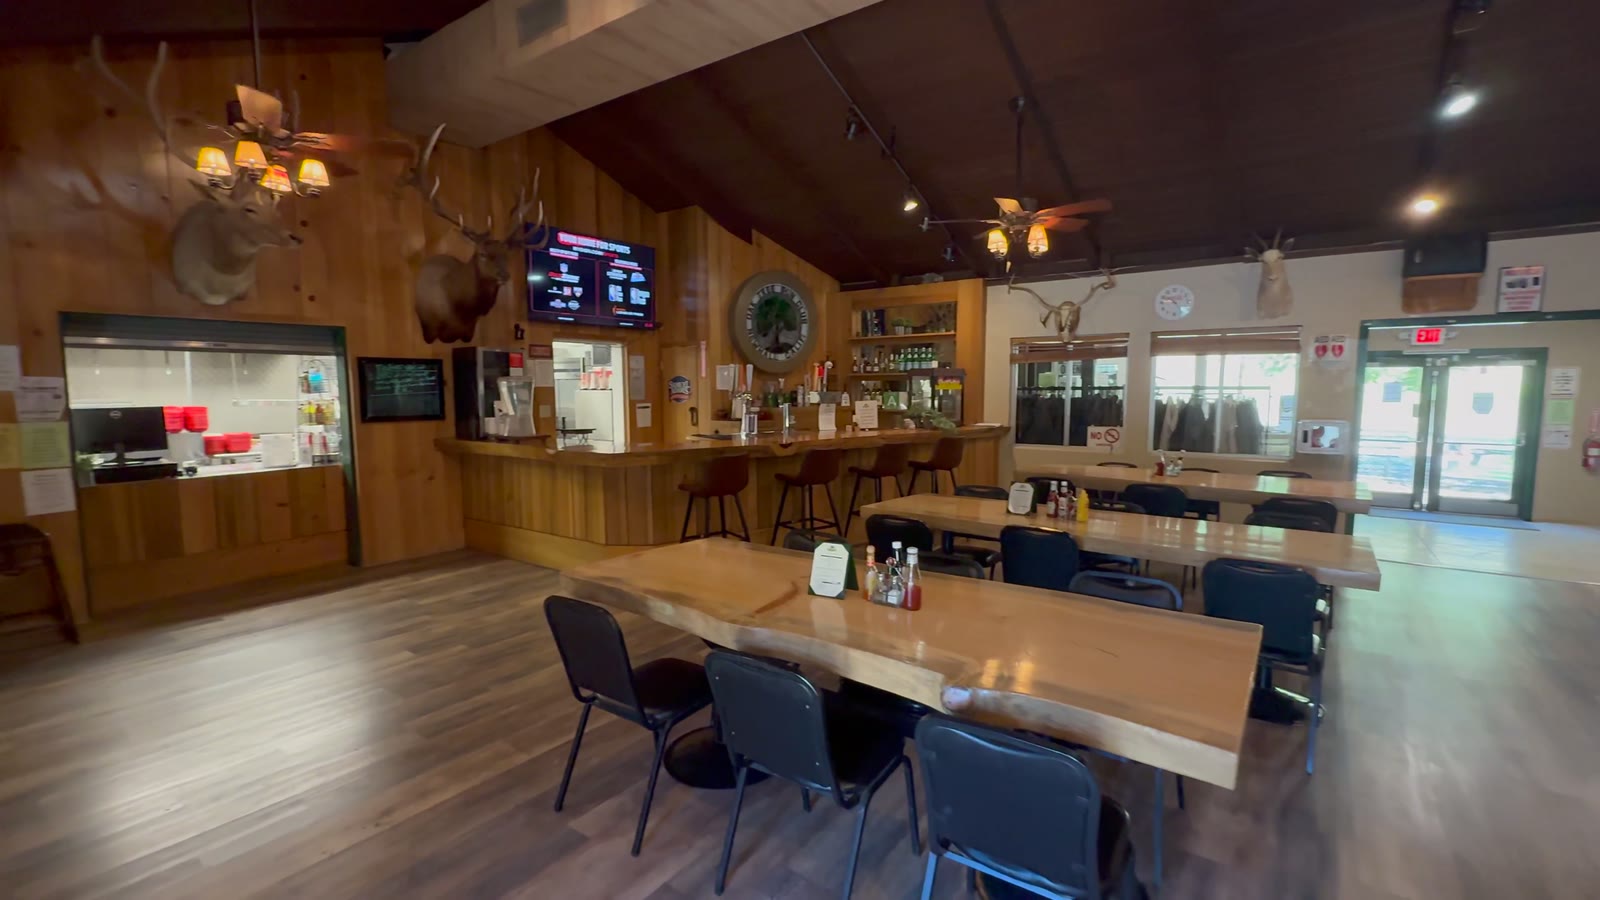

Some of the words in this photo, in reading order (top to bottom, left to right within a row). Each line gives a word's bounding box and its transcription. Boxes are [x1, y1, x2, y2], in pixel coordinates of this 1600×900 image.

[1416, 328, 1441, 343] EXIT
[887, 395, 897, 406] A
[1090, 431, 1102, 440] NO
